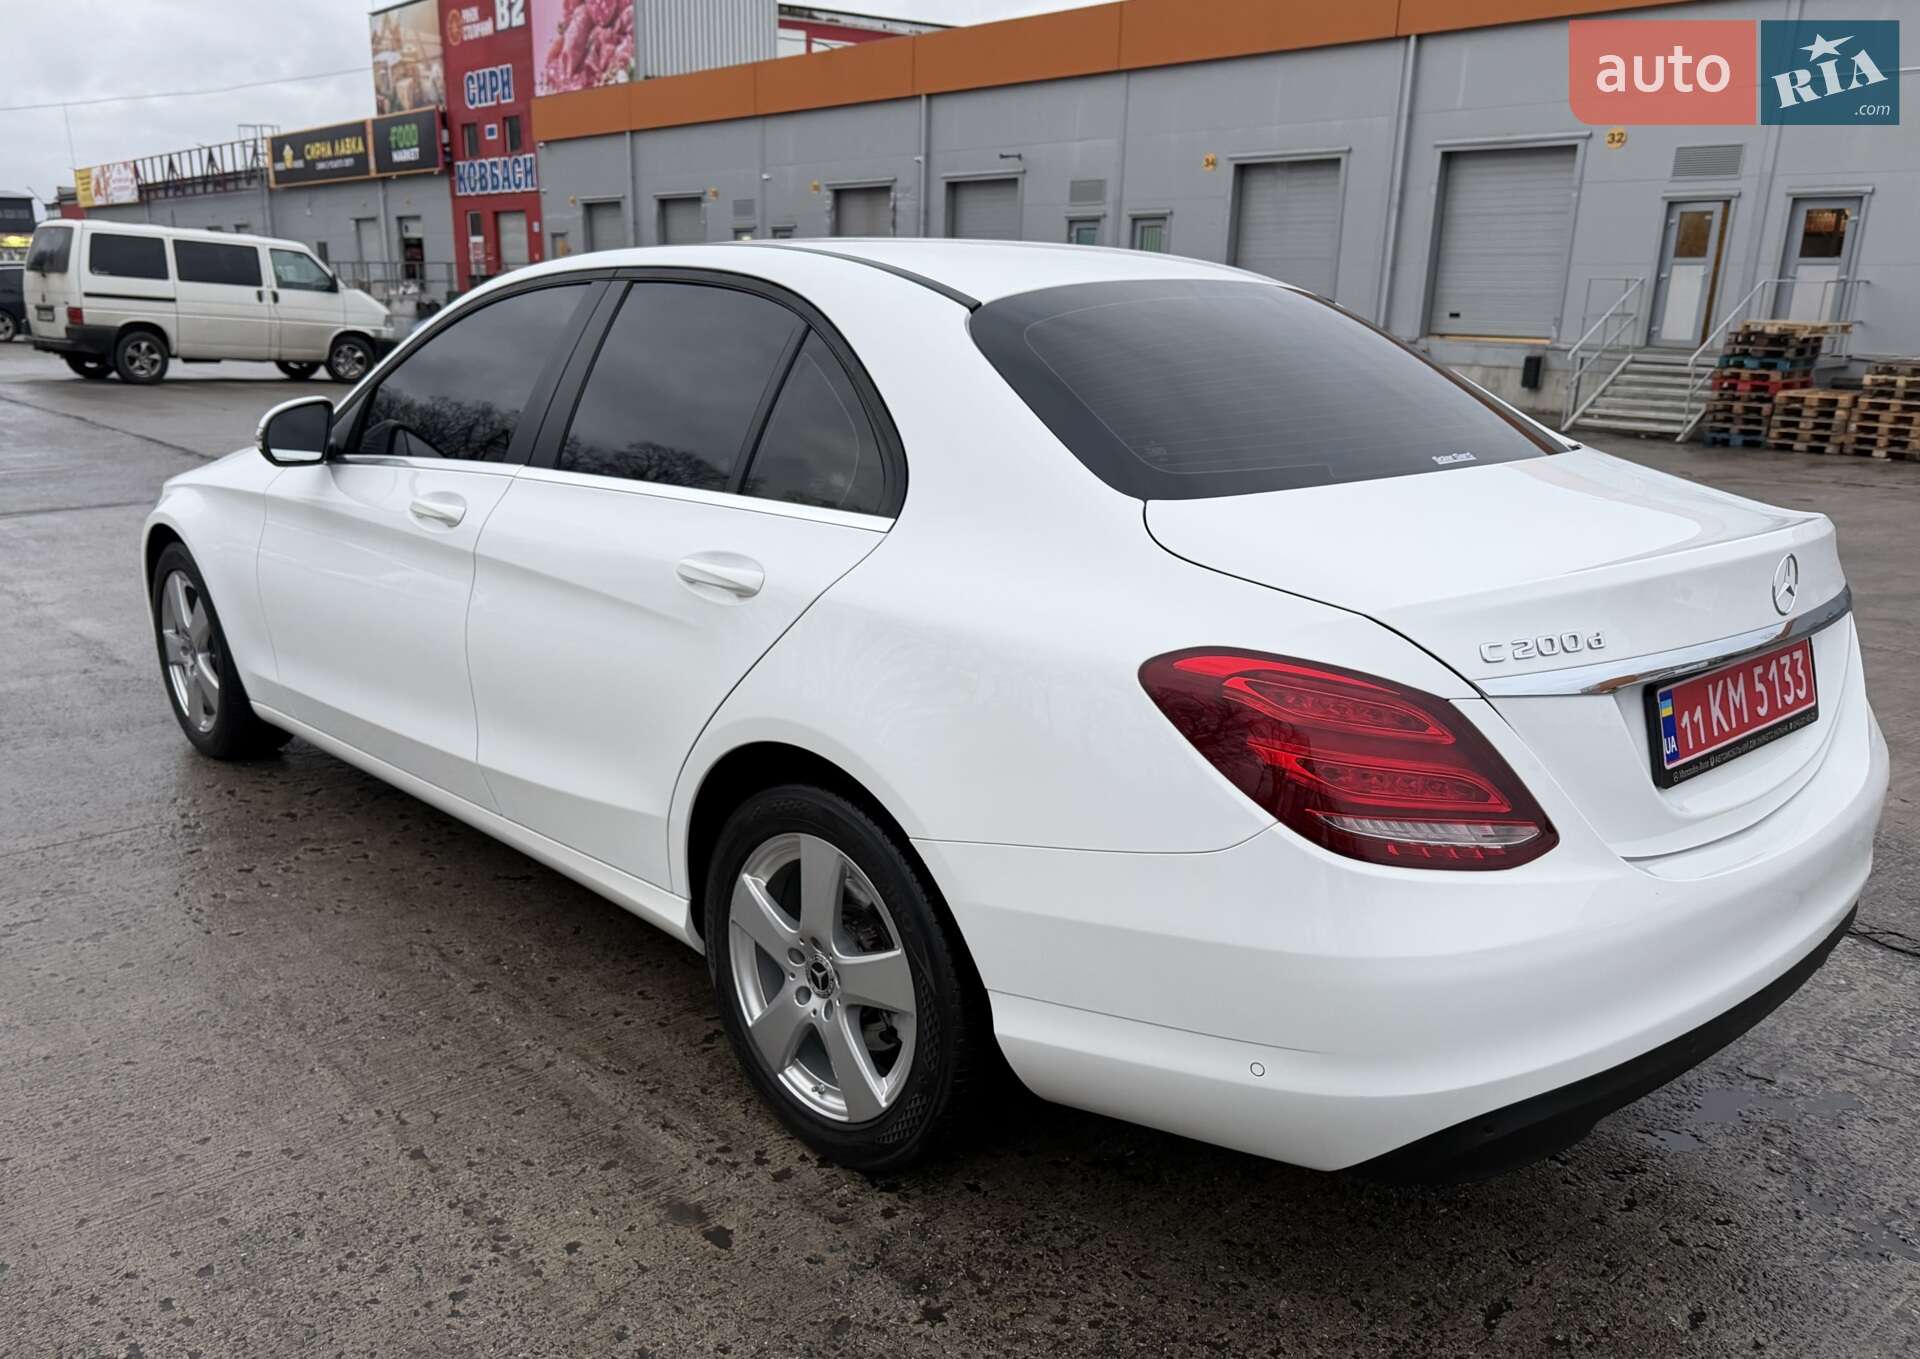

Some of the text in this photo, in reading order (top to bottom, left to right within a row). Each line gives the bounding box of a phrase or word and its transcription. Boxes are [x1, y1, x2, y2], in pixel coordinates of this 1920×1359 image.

[464, 63, 514, 109] СИРИ
[304, 135, 365, 161] СИРНА ЛАВКА
[389, 123, 418, 149] FOOD
[1607, 132, 1626, 144] 32
[392, 147, 420, 162] MARKET
[454, 153, 537, 196] КОВБАСИ
[1479, 642, 1505, 663] C
[1681, 705, 1706, 750] 11
[1707, 671, 1749, 737] KM
[1753, 649, 1808, 718] 5133
[1664, 735, 1678, 754] UA
